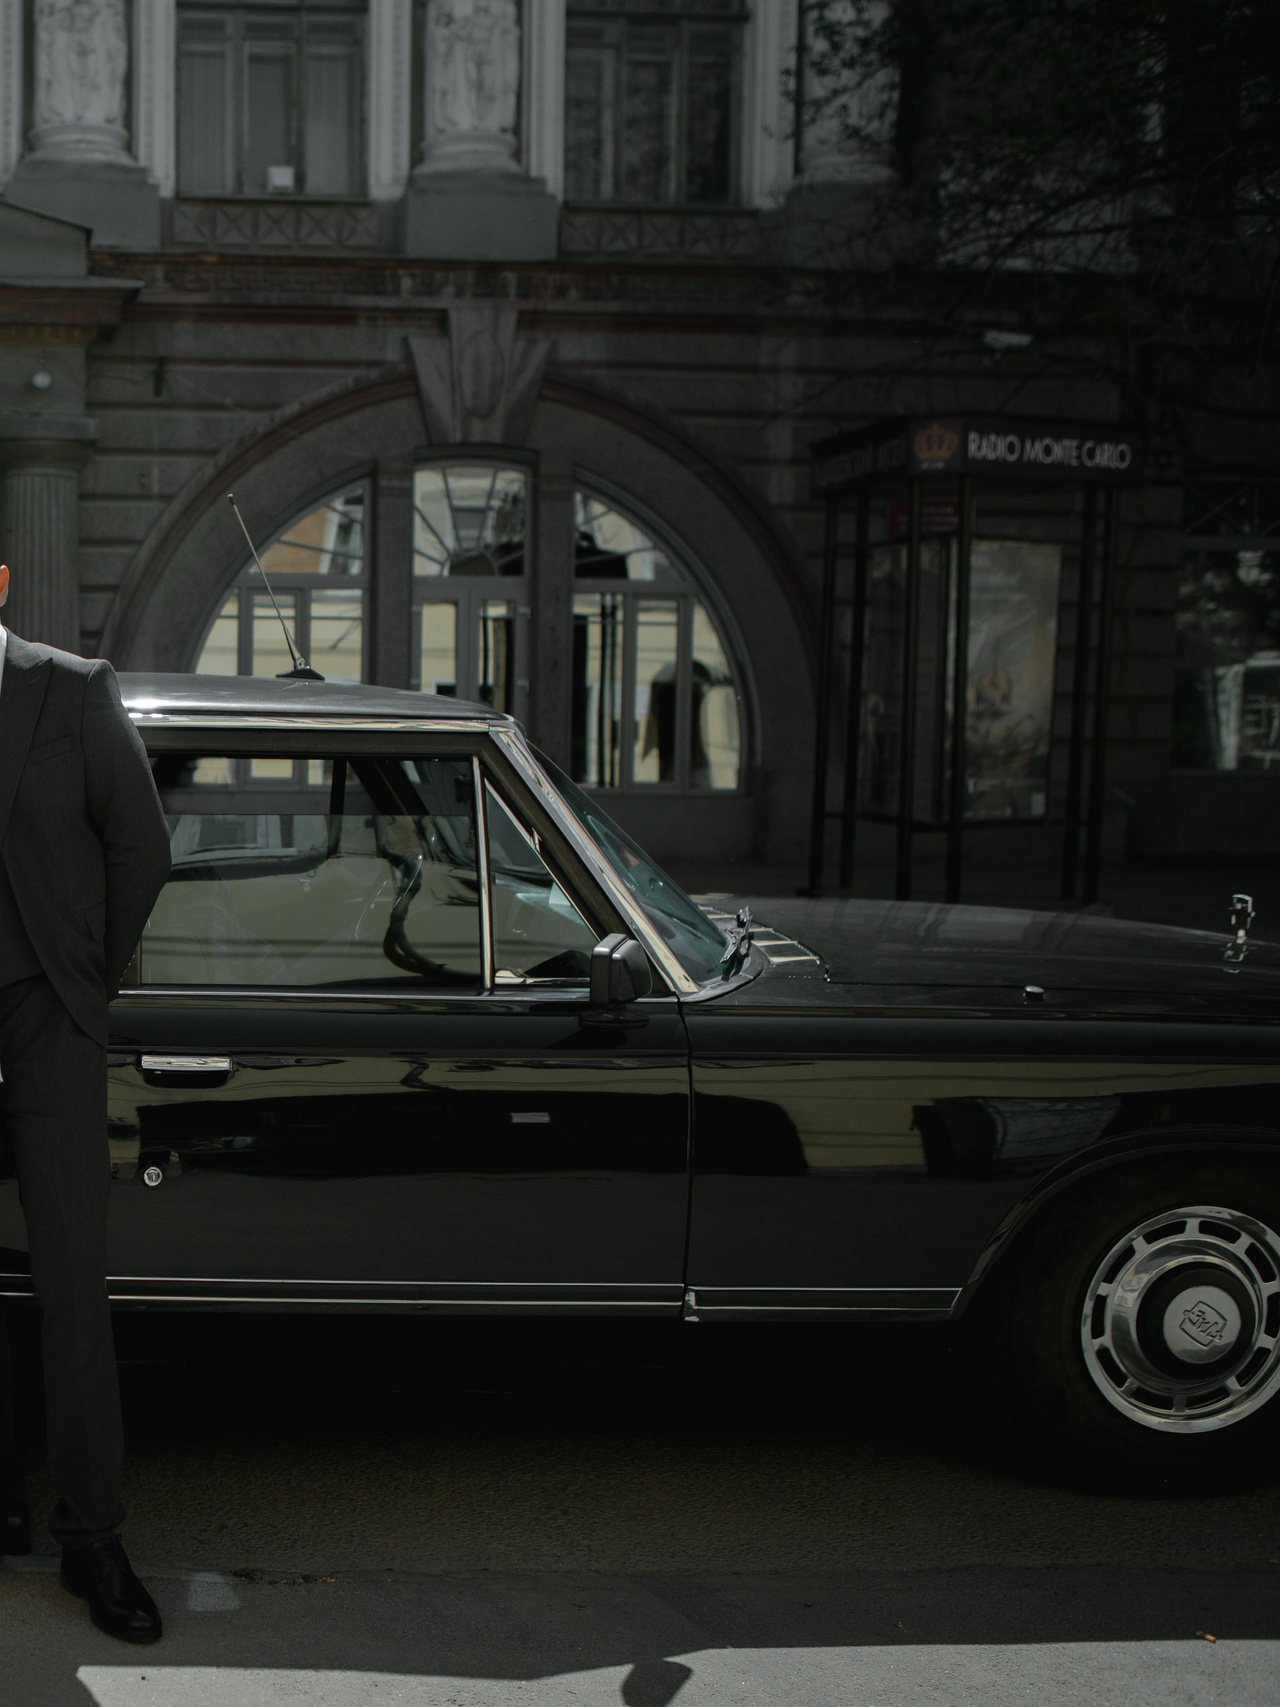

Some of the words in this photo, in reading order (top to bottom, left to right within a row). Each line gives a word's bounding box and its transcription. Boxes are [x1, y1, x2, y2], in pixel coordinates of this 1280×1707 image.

[968, 430, 1021, 463] RADIO
[1023, 436, 1081, 467] MONTE
[1081, 440, 1132, 470] CARLO
